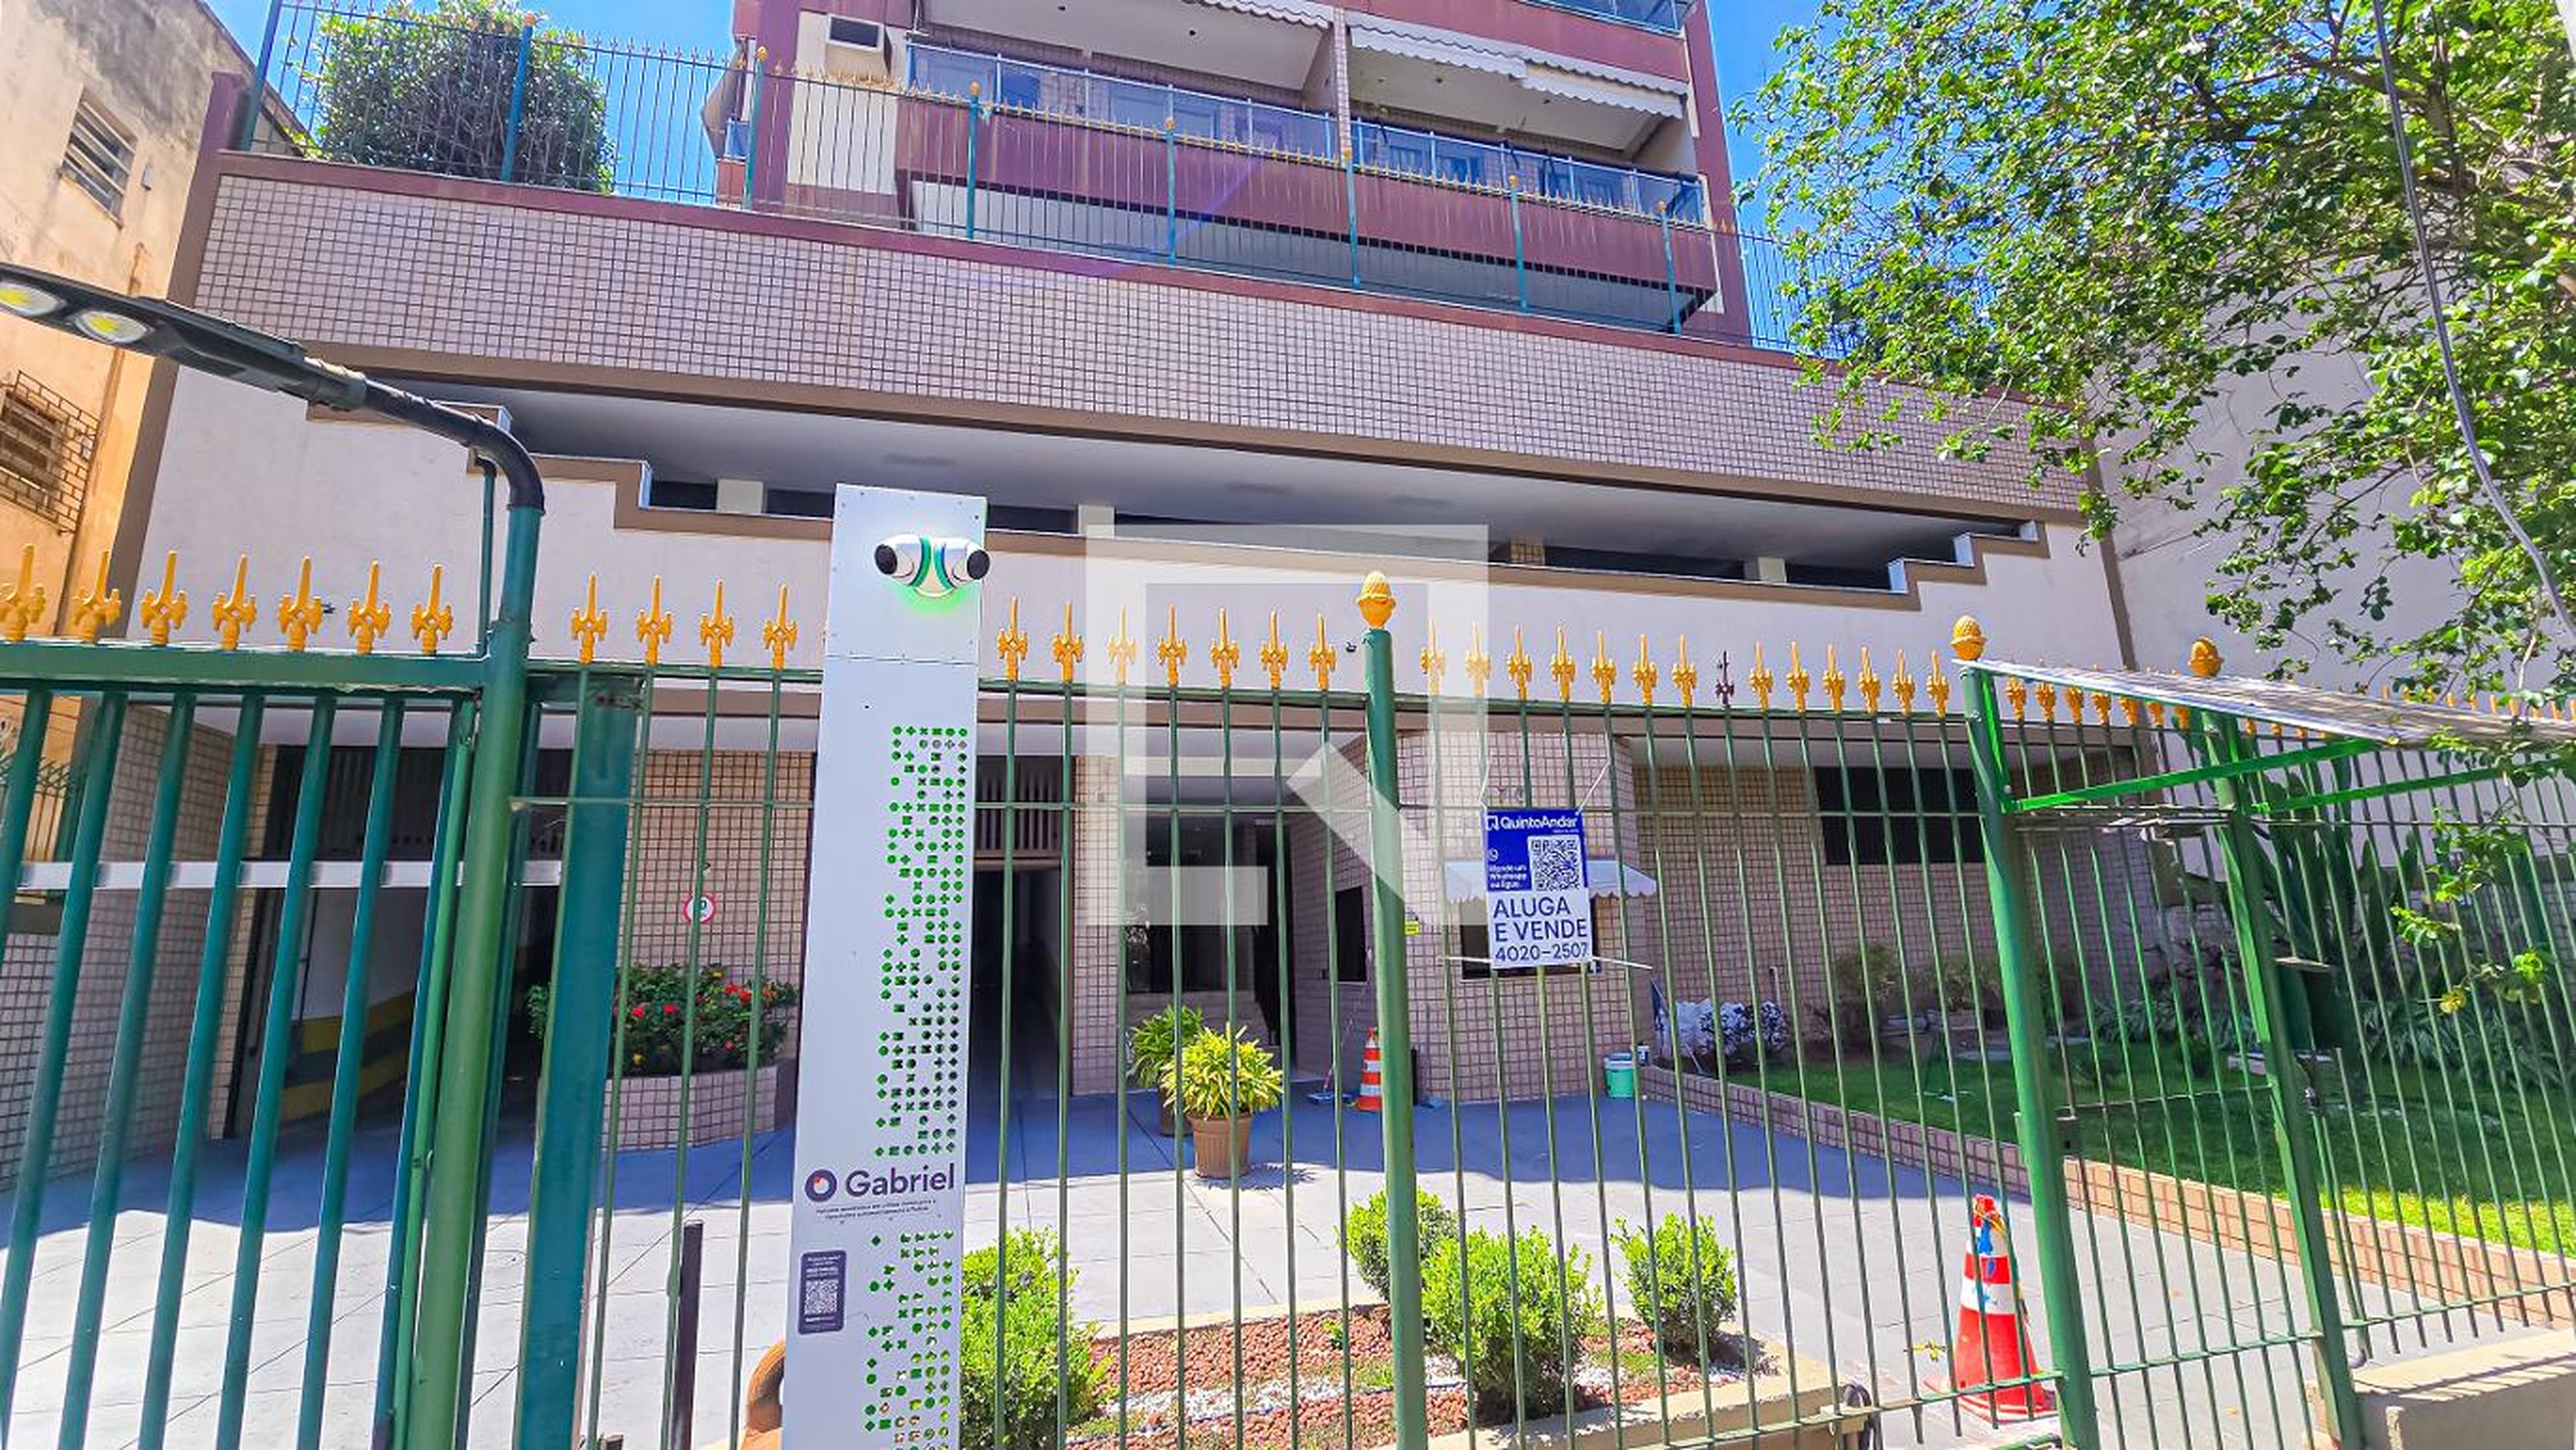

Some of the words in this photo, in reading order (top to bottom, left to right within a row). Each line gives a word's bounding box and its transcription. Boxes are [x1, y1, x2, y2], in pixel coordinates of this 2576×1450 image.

[1500, 814, 1577, 830] QuintoAndar
[1493, 897, 1570, 918] ALUGA
[1495, 922, 1508, 942] E
[1513, 918, 1588, 940] VENDE
[1495, 942, 1589, 962] 4020-2507
[845, 1162, 955, 1197] Gabriel
